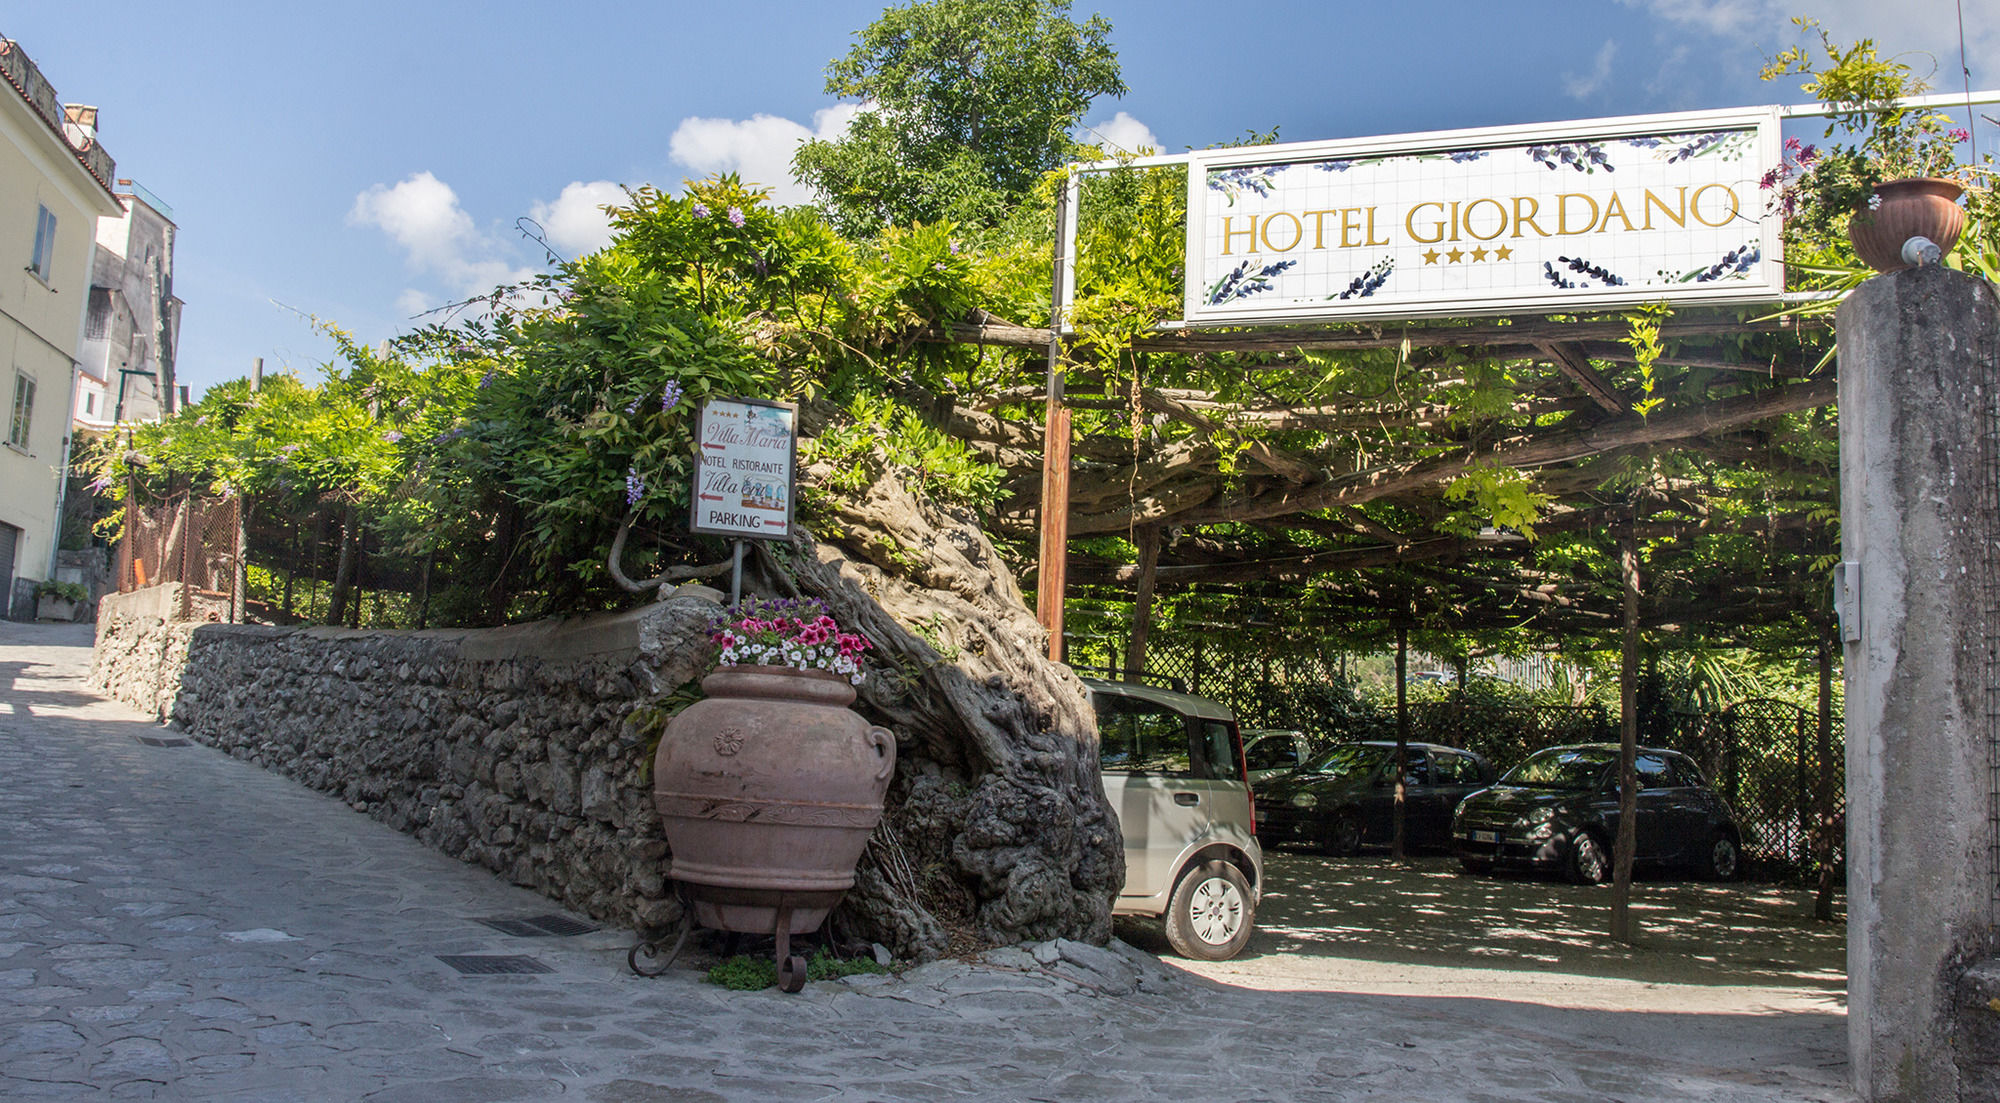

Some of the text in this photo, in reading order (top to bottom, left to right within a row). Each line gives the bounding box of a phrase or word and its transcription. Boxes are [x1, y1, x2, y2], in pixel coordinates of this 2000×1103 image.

[1220, 183, 1739, 256] HOTEL GIORDANO
[707, 422, 788, 450] Villa Maria
[700, 455, 784, 475] HOTEL RISTORANTE
[704, 470, 739, 494] Villa
[709, 510, 761, 529] PARKING
